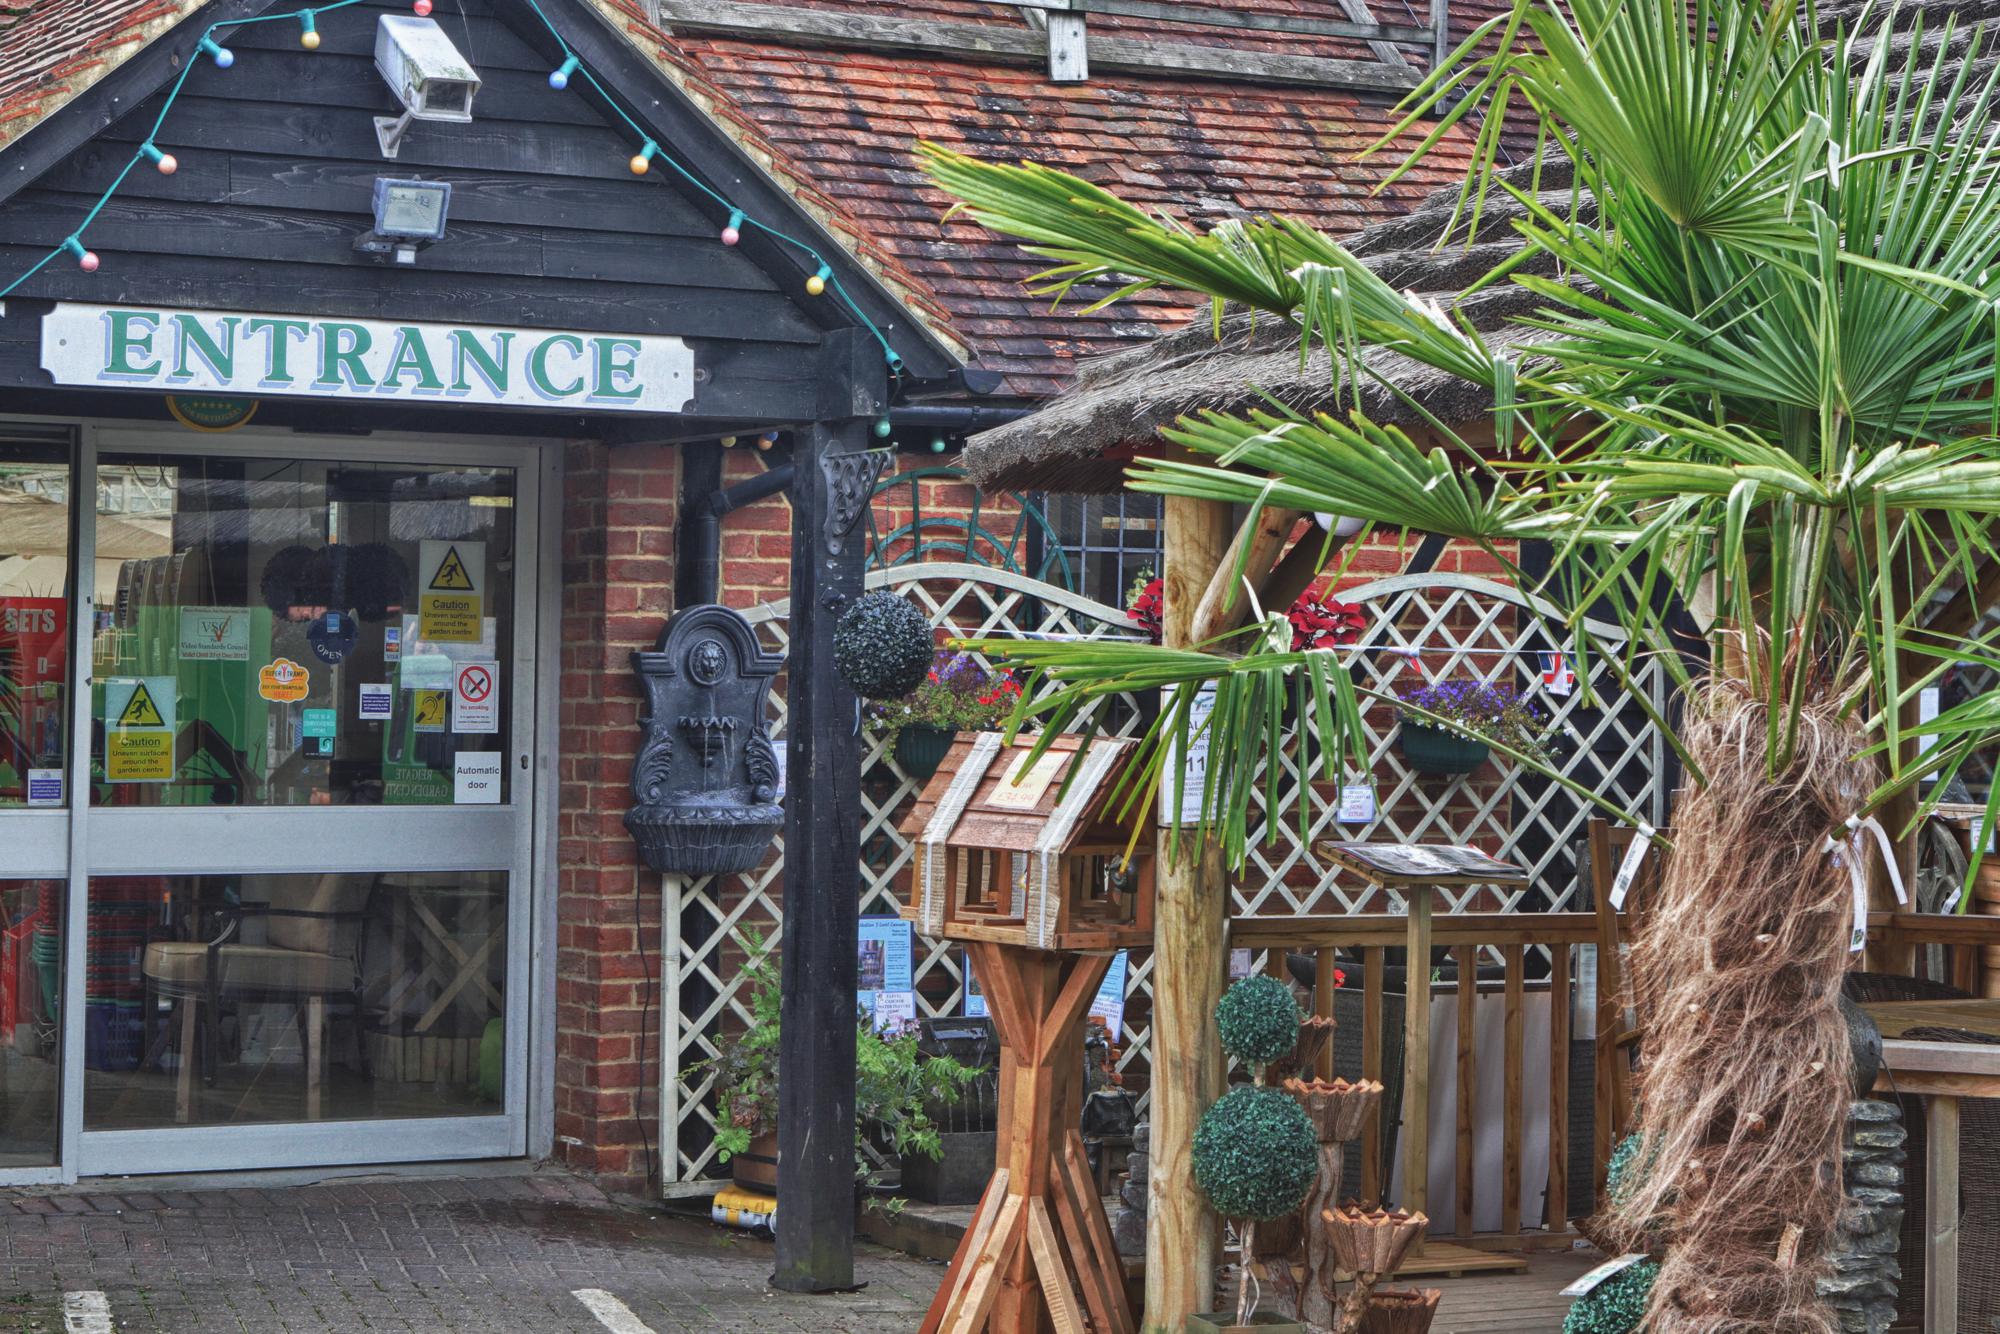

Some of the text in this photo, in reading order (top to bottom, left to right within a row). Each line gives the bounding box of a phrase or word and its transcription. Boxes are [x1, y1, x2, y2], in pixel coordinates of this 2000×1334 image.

[98, 310, 644, 404] ENTRANCE
[432, 599, 470, 609] Caution
[4, 607, 56, 634] SETS
[450, 612, 477, 620] surfaces
[317, 644, 343, 660] OPEN
[121, 736, 161, 747] Caution
[140, 749, 169, 757] surfaces
[122, 758, 147, 766] around
[117, 766, 141, 775] garden
[457, 766, 500, 775] Automatic
[467, 781, 488, 789] door
